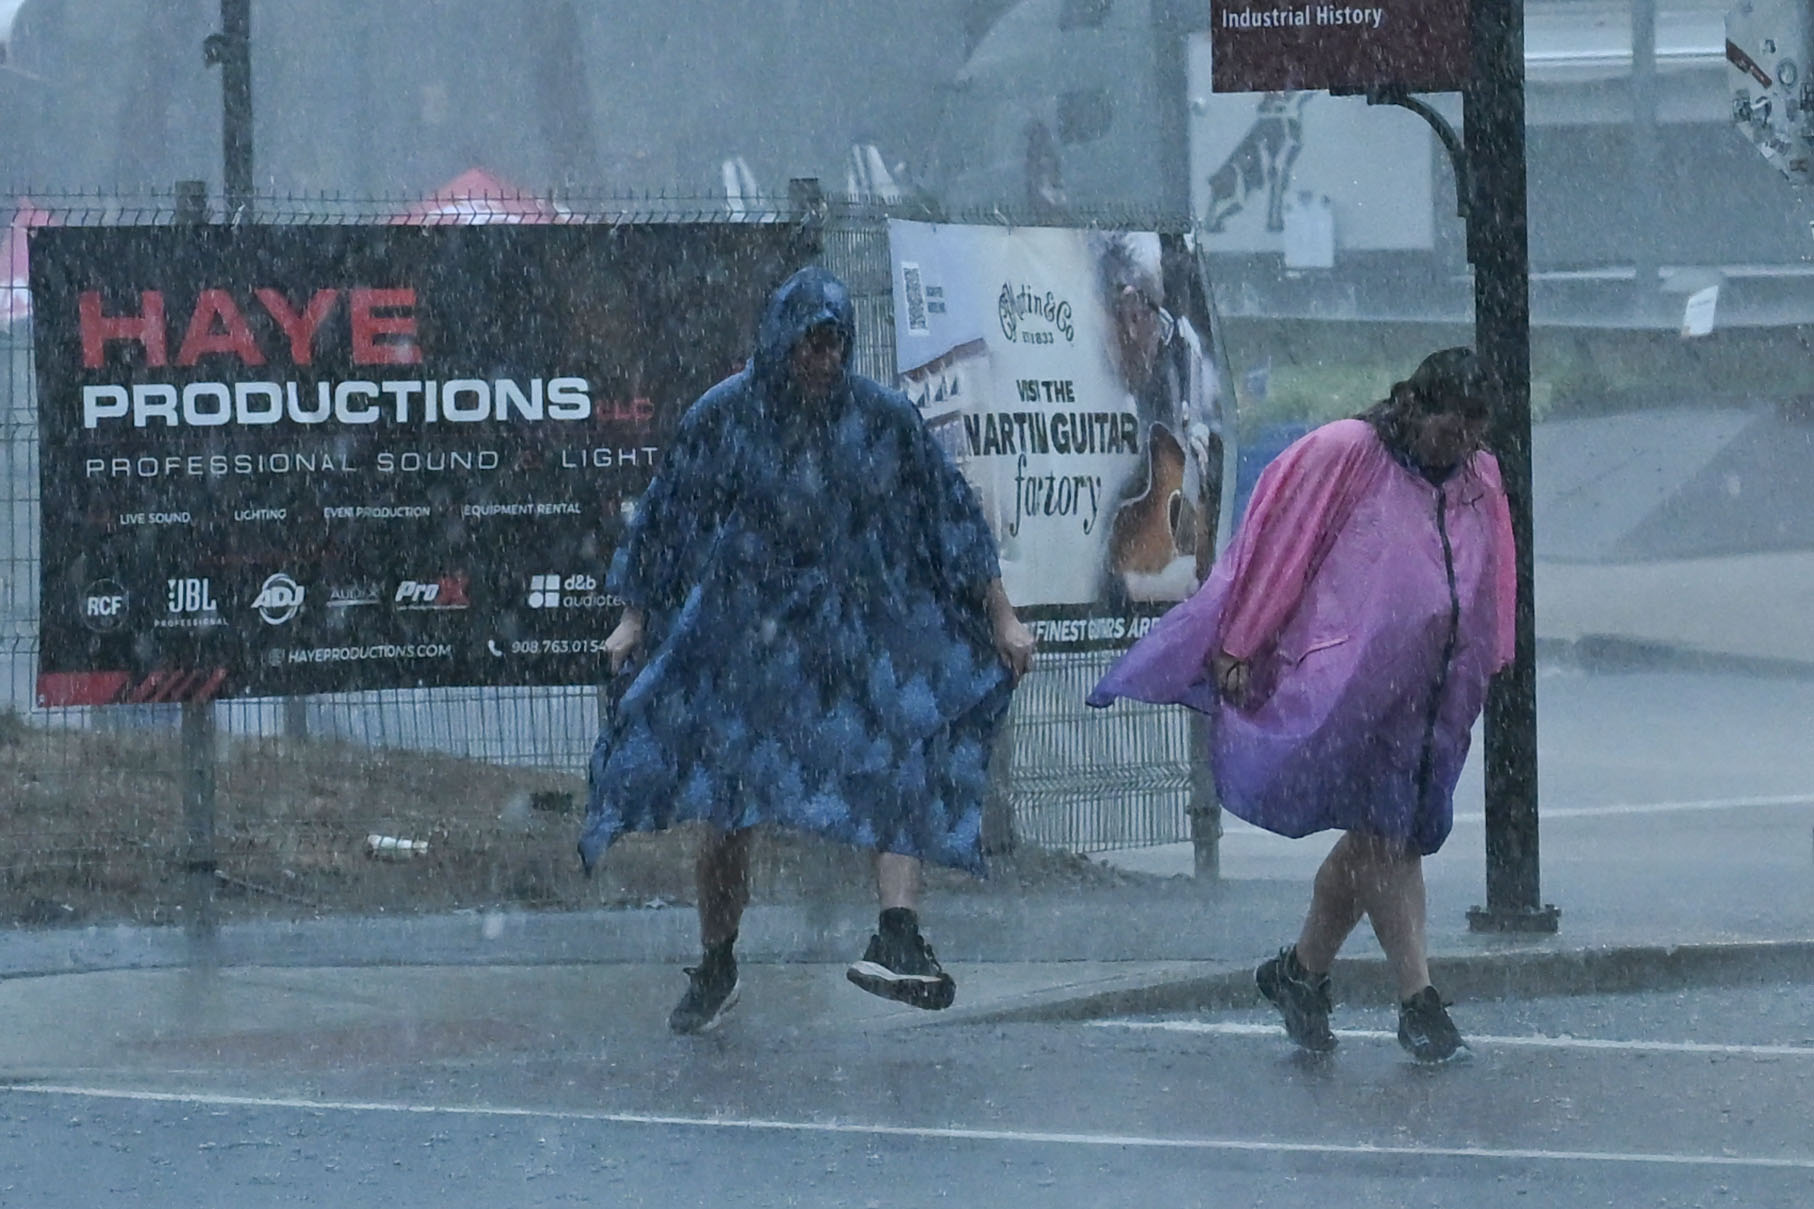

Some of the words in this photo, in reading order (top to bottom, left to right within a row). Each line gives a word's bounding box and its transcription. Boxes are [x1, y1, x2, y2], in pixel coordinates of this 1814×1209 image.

[1222, 5, 1310, 28] Industrial
[1316, 5, 1382, 28] History
[79, 287, 424, 369] HAYE
[82, 377, 592, 429] PRODUCTIONS
[1041, 380, 1075, 403] THE
[1050, 412, 1140, 455] GUITAR
[86, 453, 357, 478] PROFESSIONAL
[376, 451, 499, 473] SOUND
[120, 513, 145, 525] LIVE
[148, 511, 191, 524] SOUND
[464, 503, 534, 517] EQUIPMENT
[537, 502, 582, 515] RENTAL
[564, 574, 597, 591] d&b
[87, 596, 122, 616] RCF
[169, 578, 217, 613] JBL
[1036, 618, 1087, 642] FINEST
